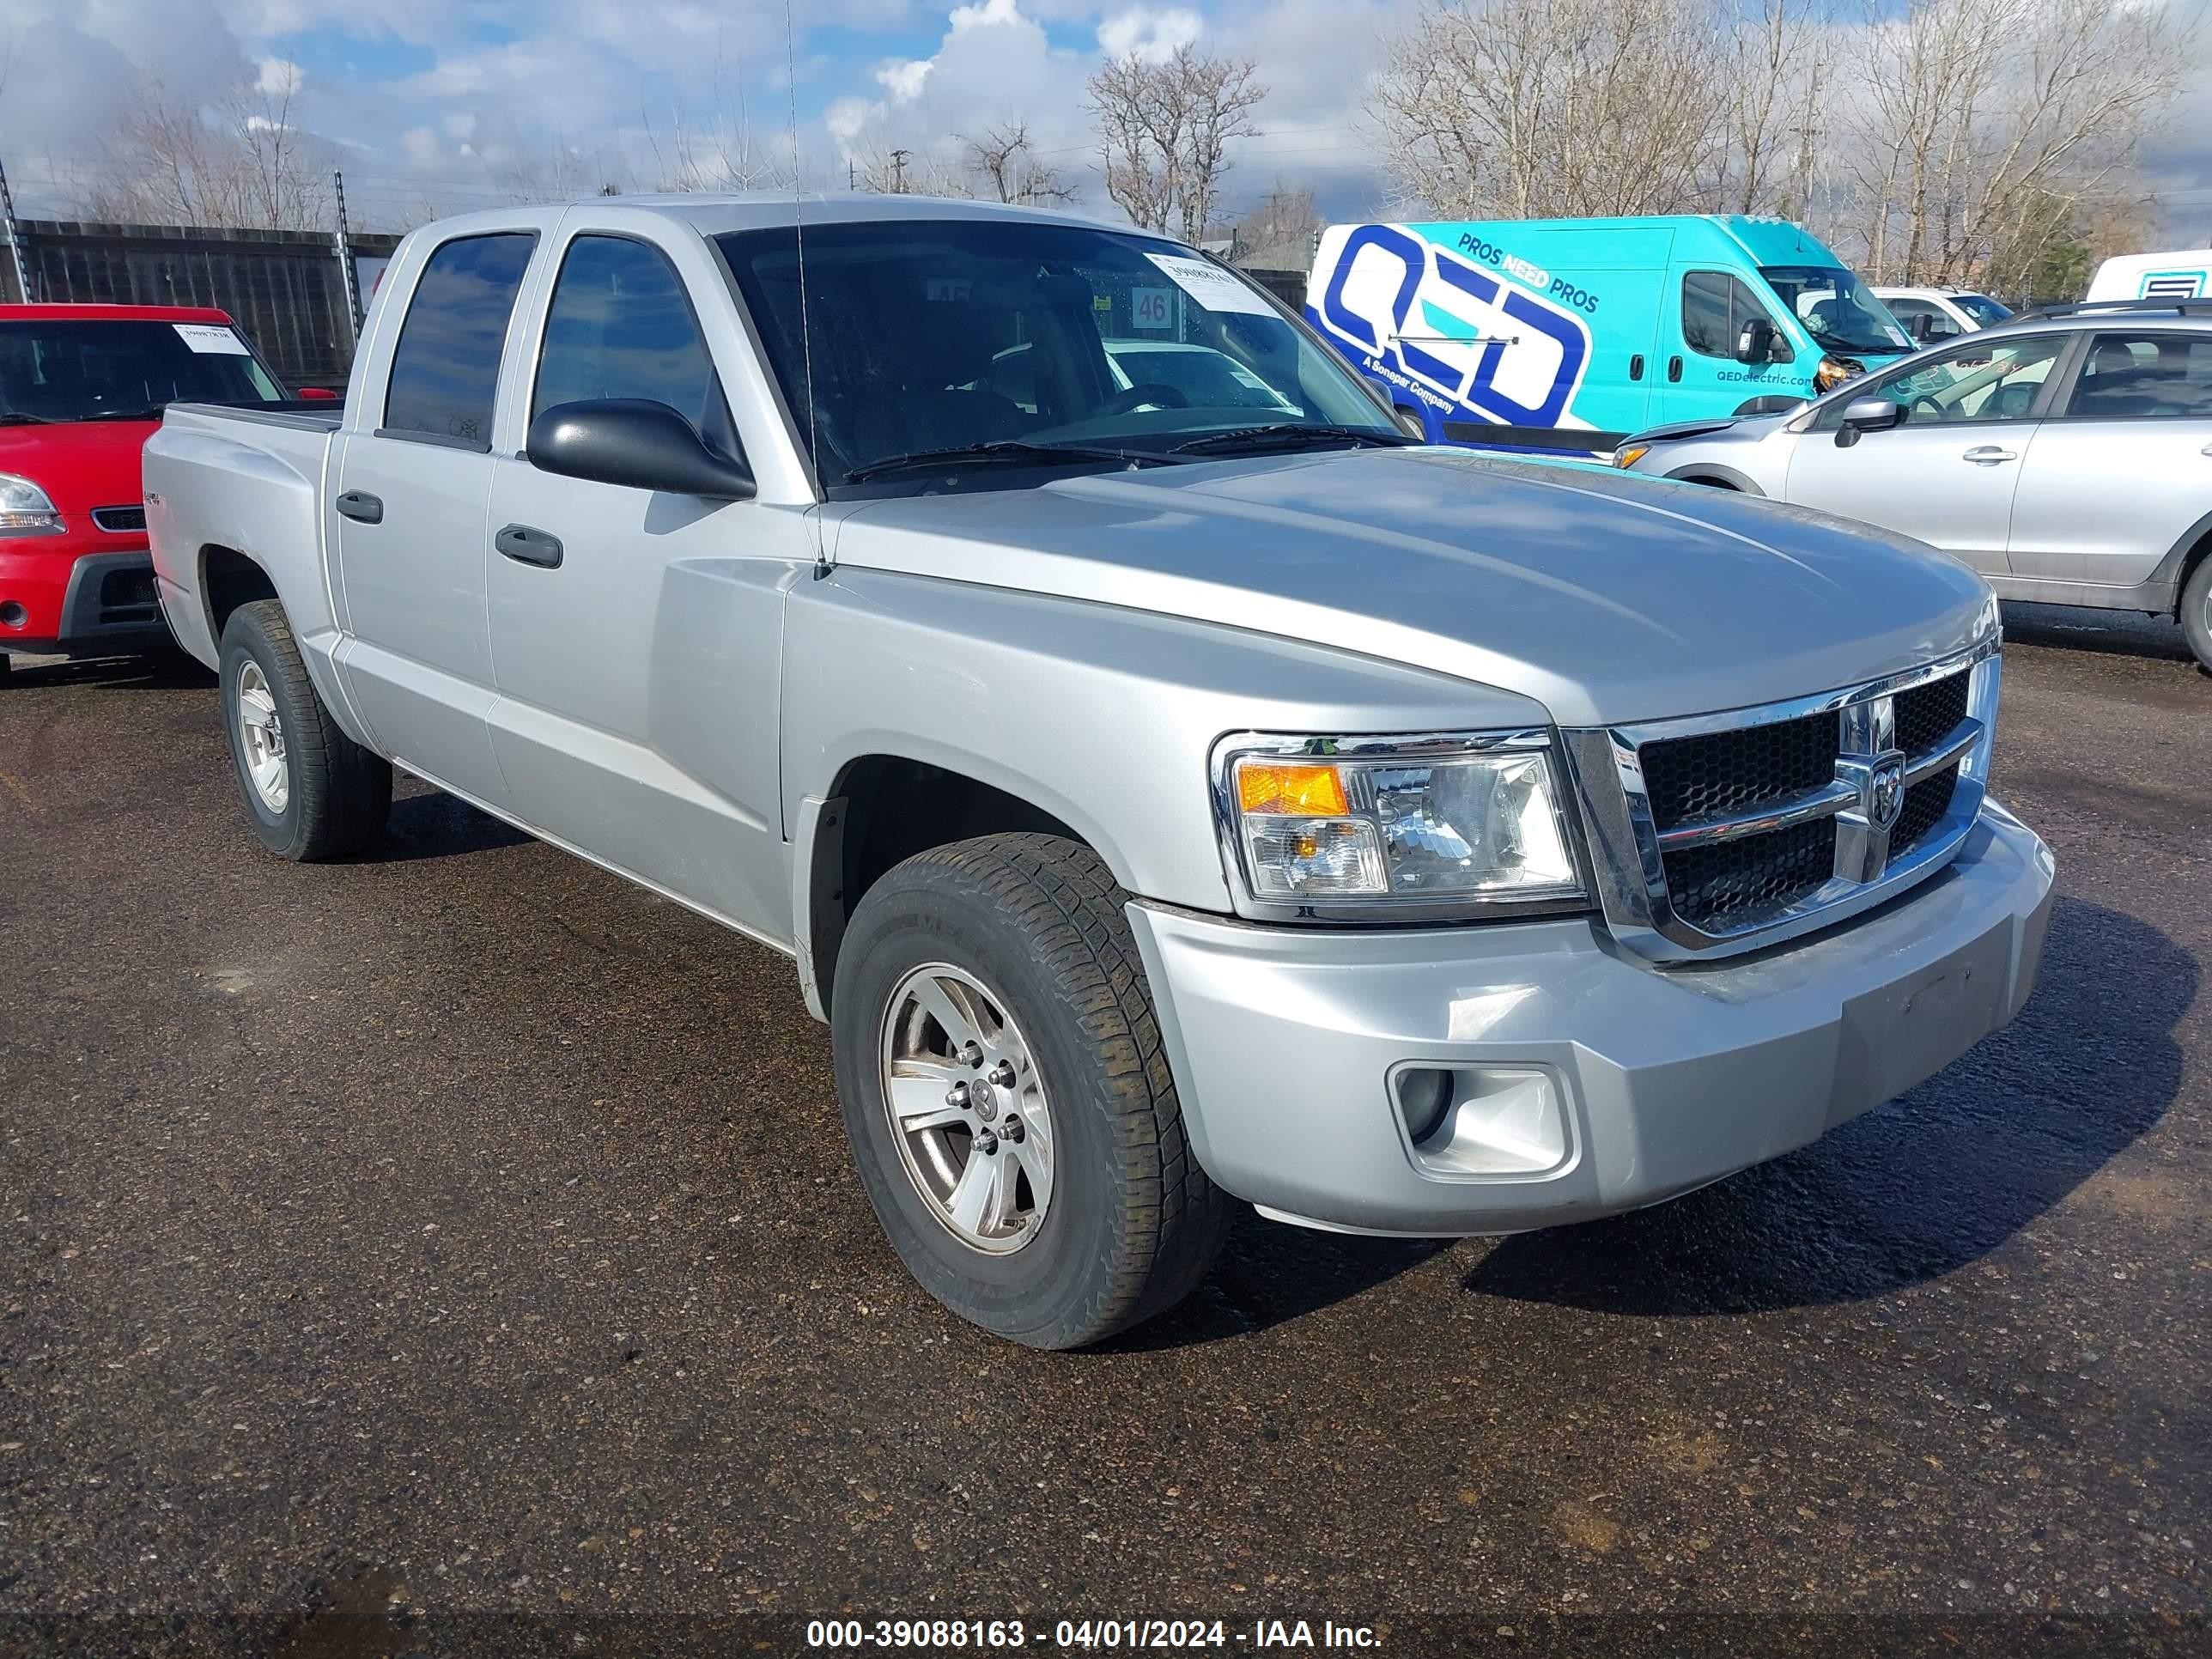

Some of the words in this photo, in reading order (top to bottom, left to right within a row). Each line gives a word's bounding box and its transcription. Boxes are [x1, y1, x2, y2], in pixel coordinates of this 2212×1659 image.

[1168, 265, 1237, 285] 39088163
[1458, 233, 1503, 265] PROS
[1503, 254, 1549, 289] NEED
[1549, 278, 1599, 313] PROS
[1139, 295, 1166, 322] 46
[1362, 355, 1371, 368] A
[1371, 359, 1411, 388] Sonepar
[1409, 381, 1455, 415] Company
